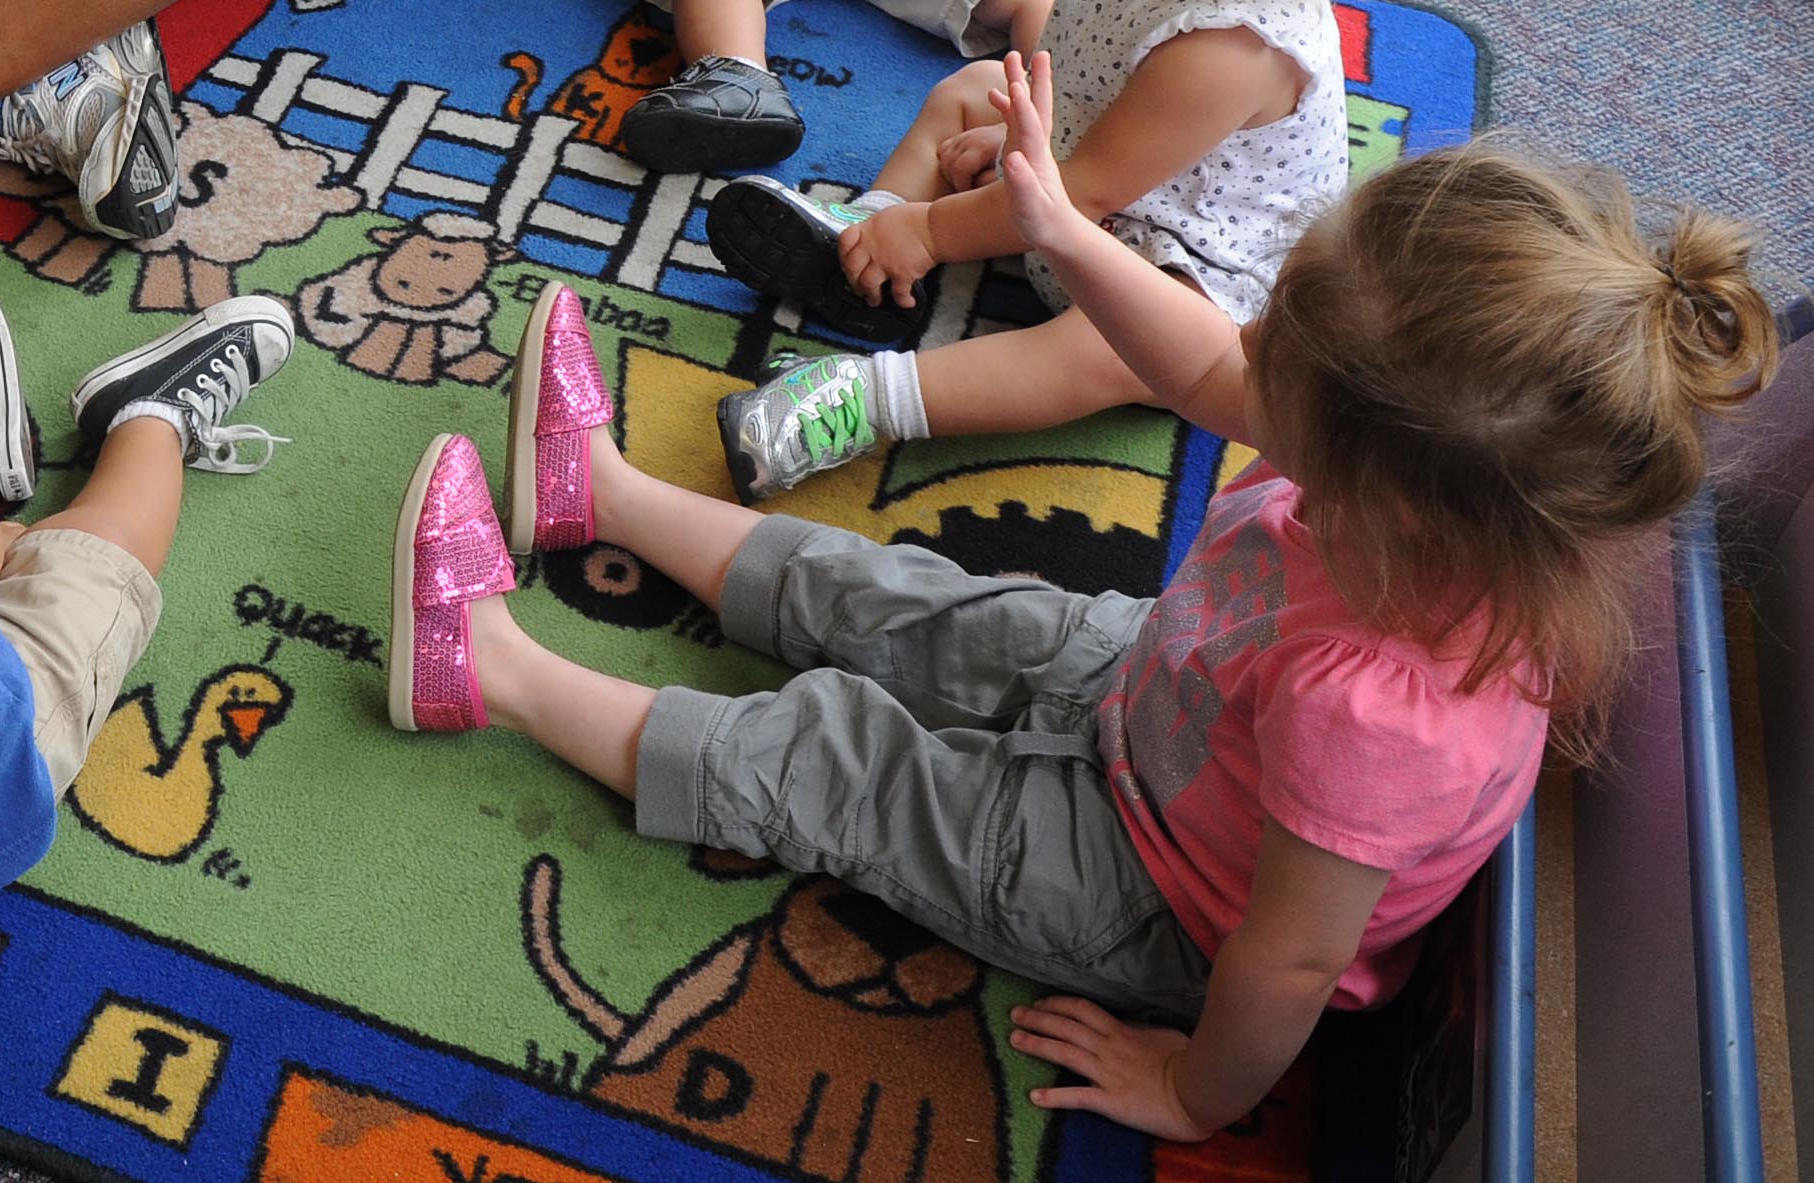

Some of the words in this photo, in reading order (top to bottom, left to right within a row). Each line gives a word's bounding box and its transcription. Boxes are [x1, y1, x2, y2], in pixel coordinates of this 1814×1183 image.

[48, 60, 88, 102] N
[767, 54, 853, 88] eow
[178, 159, 229, 208] S
[314, 285, 354, 326] L
[233, 583, 383, 670] Quack
[105, 1027, 193, 1114] I
[675, 1046, 755, 1123] D
